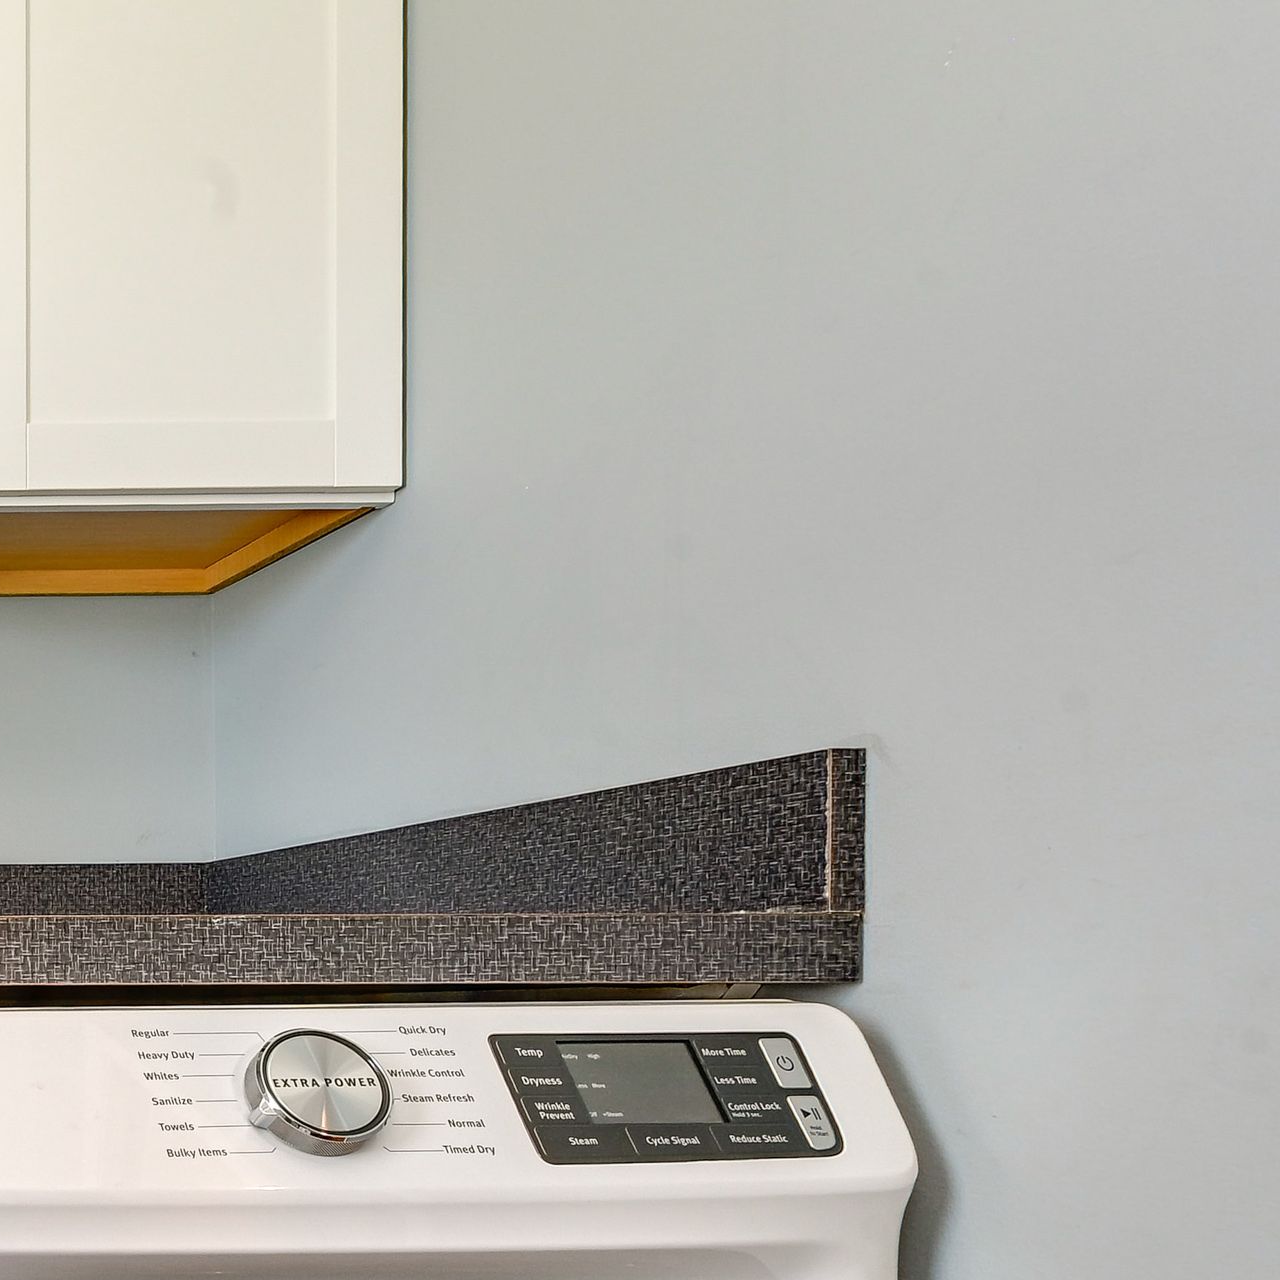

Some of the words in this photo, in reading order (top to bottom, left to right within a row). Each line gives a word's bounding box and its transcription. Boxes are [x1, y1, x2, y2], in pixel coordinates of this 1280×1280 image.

[131, 1029, 170, 1040] Regular
[398, 1026, 426, 1035] Quick
[427, 1026, 446, 1036] Dry
[138, 1050, 169, 1061] Heavy
[171, 1050, 195, 1061] Duty
[410, 1048, 456, 1057] Delicates
[514, 1047, 543, 1059] Temp
[701, 1048, 724, 1056] More
[724, 1048, 747, 1056] Time
[143, 1072, 179, 1081] Whites
[387, 1068, 425, 1078] Wrinkle
[427, 1068, 465, 1078] Control
[272, 1078, 320, 1088] EXTRA
[324, 1078, 377, 1088] POWER
[521, 1076, 562, 1086] Dryness
[714, 1076, 734, 1084] Less
[735, 1076, 757, 1084] Time
[152, 1096, 193, 1106] Sanitize
[401, 1094, 433, 1103] Steam
[436, 1093, 475, 1103] Refresh
[535, 1102, 570, 1111] Wrinkle
[728, 1102, 760, 1110] Control
[540, 1111, 575, 1120] Prevent
[158, 1122, 195, 1132] Towels
[448, 1118, 485, 1128] Normal
[568, 1136, 598, 1146] Steam
[646, 1136, 669, 1147] Cycle
[671, 1135, 700, 1146] Signal
[729, 1135, 762, 1143] Reduce
[762, 1134, 788, 1143] Static
[166, 1148, 196, 1160] Bulky
[198, 1148, 228, 1157] Items
[442, 1145, 474, 1154] Timed
[476, 1145, 495, 1156] Dry
